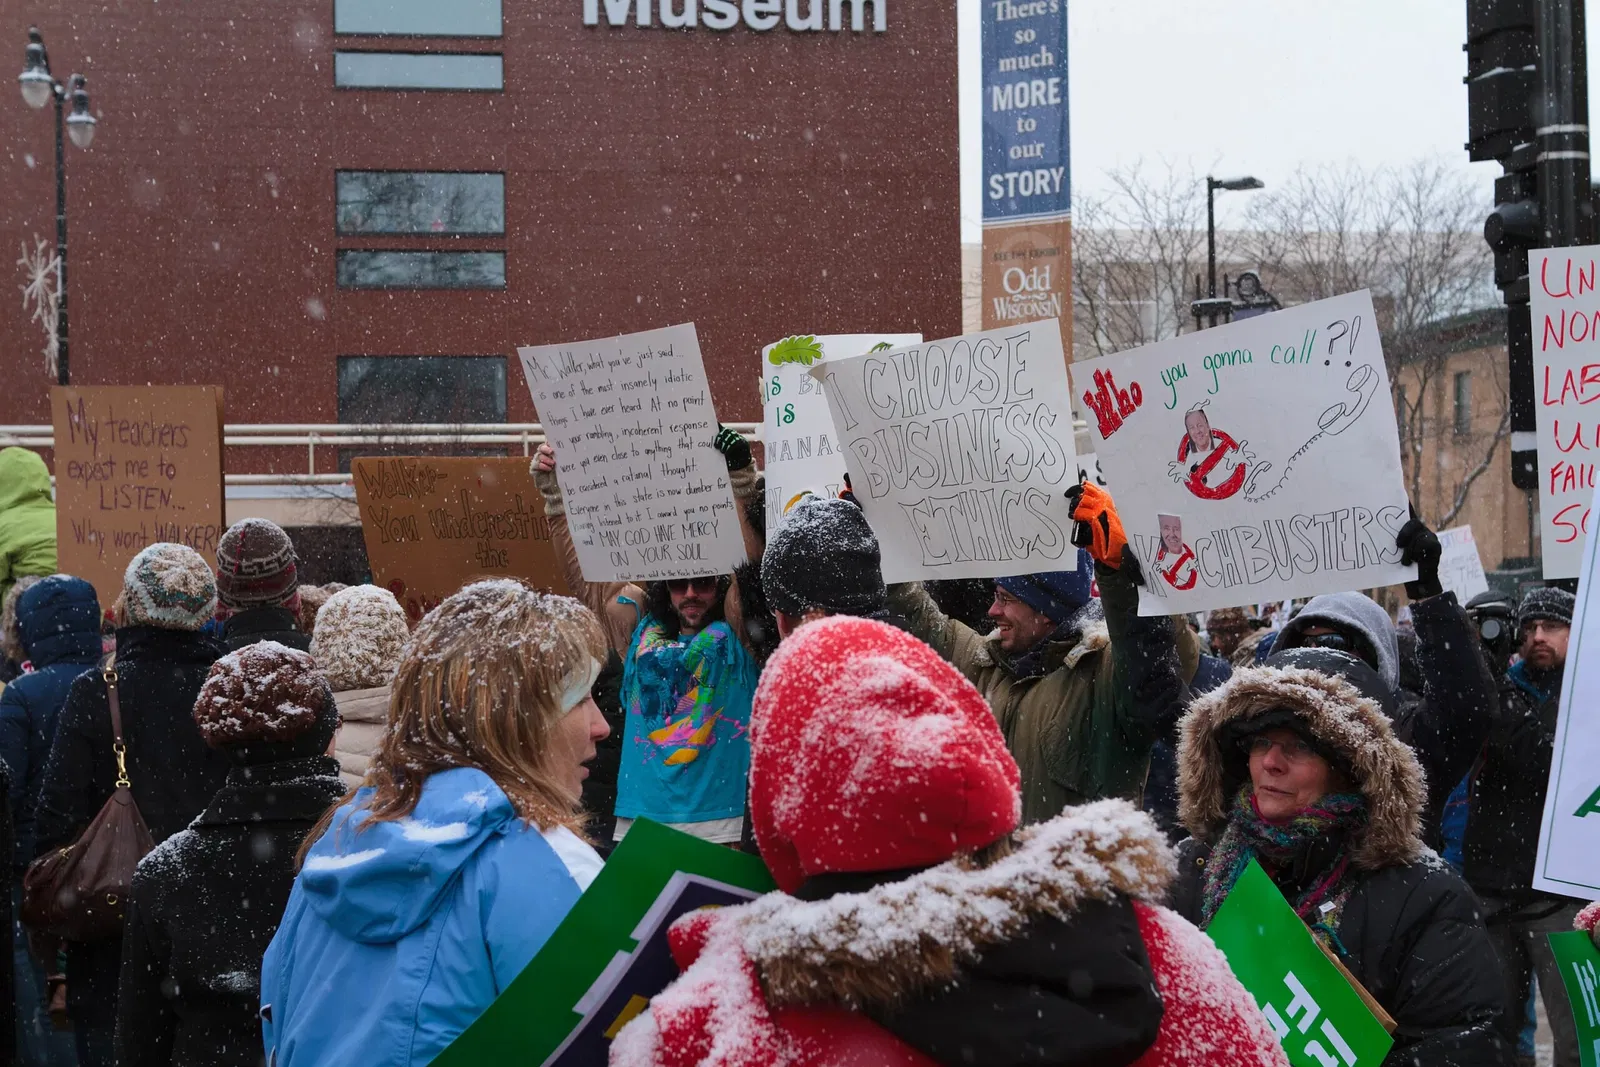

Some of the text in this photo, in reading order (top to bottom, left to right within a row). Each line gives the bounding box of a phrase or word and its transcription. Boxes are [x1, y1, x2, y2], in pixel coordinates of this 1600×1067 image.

[992, 0, 1059, 21] Theres
[1014, 28, 1036, 45] so
[999, 45, 1055, 72] much
[992, 77, 1061, 112] MORE
[1016, 118, 1037, 133] to
[1009, 142, 1045, 159] our
[989, 167, 1065, 200] STORY
[1003, 264, 1052, 295] Odd
[586, 352, 604, 370] what
[608, 348, 631, 373] you've
[636, 345, 654, 369] just
[540, 367, 694, 401] is one of the most insanely idiotic
[824, 331, 1034, 431] I CHOOSE
[1082, 368, 1143, 441] Who
[1160, 362, 1188, 410] you
[1203, 348, 1253, 394] gonna
[546, 390, 705, 429] things I have ever heard At no point
[776, 403, 796, 428] IS
[66, 396, 192, 460] My teachers
[555, 437, 565, 449] in
[568, 434, 582, 453] your
[621, 418, 664, 437] incoherent
[669, 421, 709, 438] response
[560, 435, 715, 475] were you even close to anything that coul
[767, 433, 842, 464] NANA
[848, 403, 1067, 498] BUSINESS
[67, 453, 177, 490] expect me to
[565, 481, 576, 496] be
[578, 474, 609, 493] considered
[613, 478, 619, 486] a
[621, 463, 652, 482] rational
[568, 477, 728, 520] Everyone in this state is now dumber for
[367, 505, 421, 545] You
[571, 519, 596, 534] having
[596, 513, 623, 527] listened
[625, 512, 634, 524] to
[645, 506, 655, 520] I
[656, 506, 678, 519] award
[683, 507, 696, 522] you
[699, 504, 709, 513] no
[582, 518, 719, 548] and MAY GOD HAVE MERCY
[898, 487, 1066, 567] ETHICS
[70, 517, 105, 558] Why
[113, 520, 150, 551] won't
[475, 538, 510, 569] the
[610, 542, 709, 567] ON YOUR SOUL
